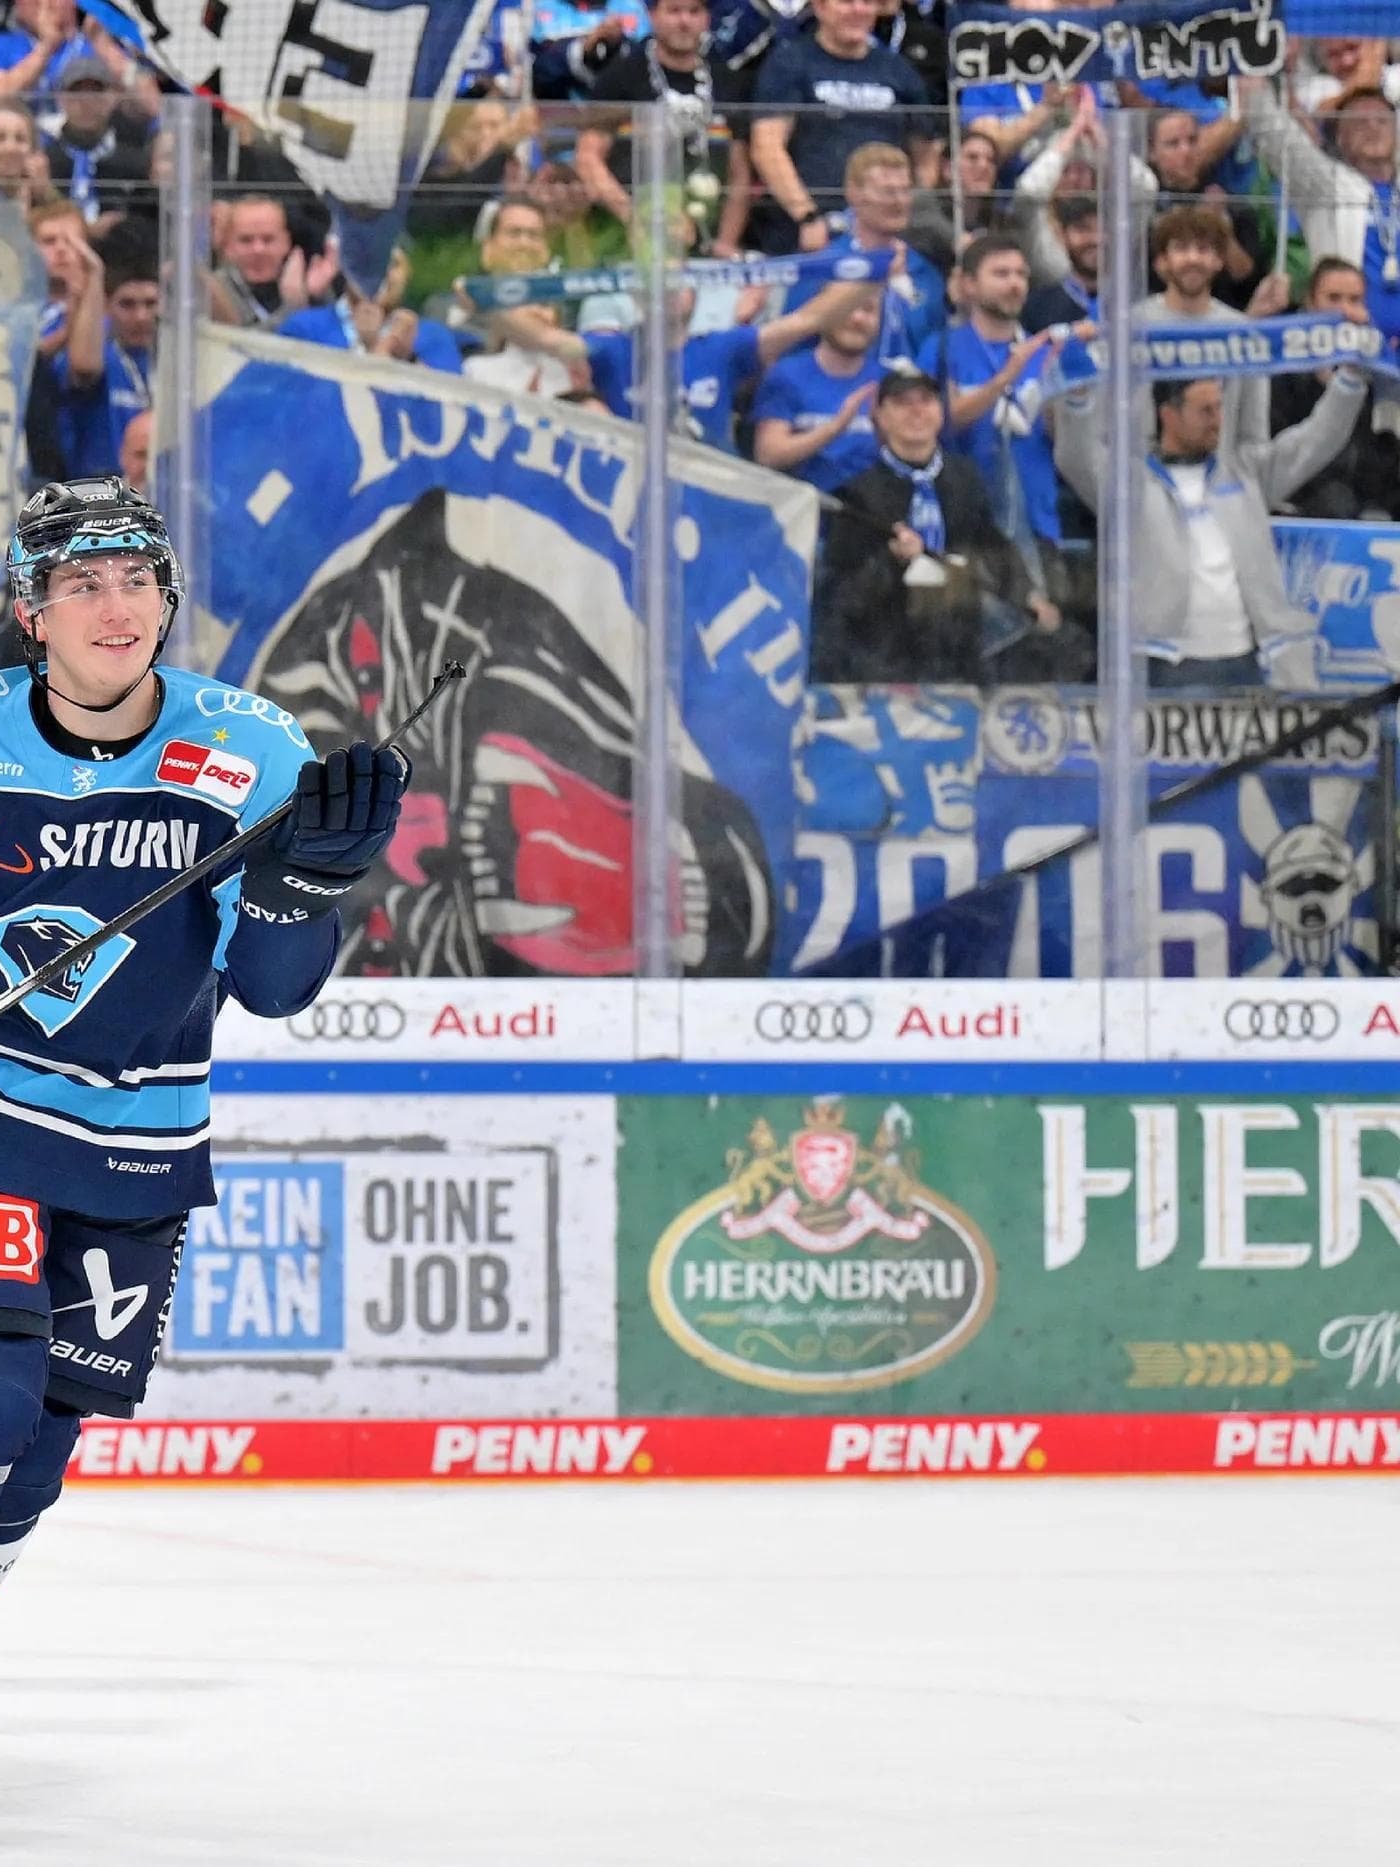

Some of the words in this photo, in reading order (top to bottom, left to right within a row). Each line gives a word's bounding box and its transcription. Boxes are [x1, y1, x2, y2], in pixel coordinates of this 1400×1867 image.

[83, 516, 132, 528] BAUER
[38, 818, 200, 872] SATURN
[282, 875, 353, 896] OOD
[430, 1004, 556, 1038] Audi
[895, 1004, 1021, 1038] Audi
[117, 1160, 173, 1175] BAUER
[1036, 1102, 1400, 1271] HER
[190, 1178, 321, 1250] KEIN
[364, 1179, 514, 1245] OHNE
[192, 1253, 322, 1338] FAN
[364, 1254, 530, 1337] JOB.
[683, 1258, 966, 1303] HERRNBRÄU
